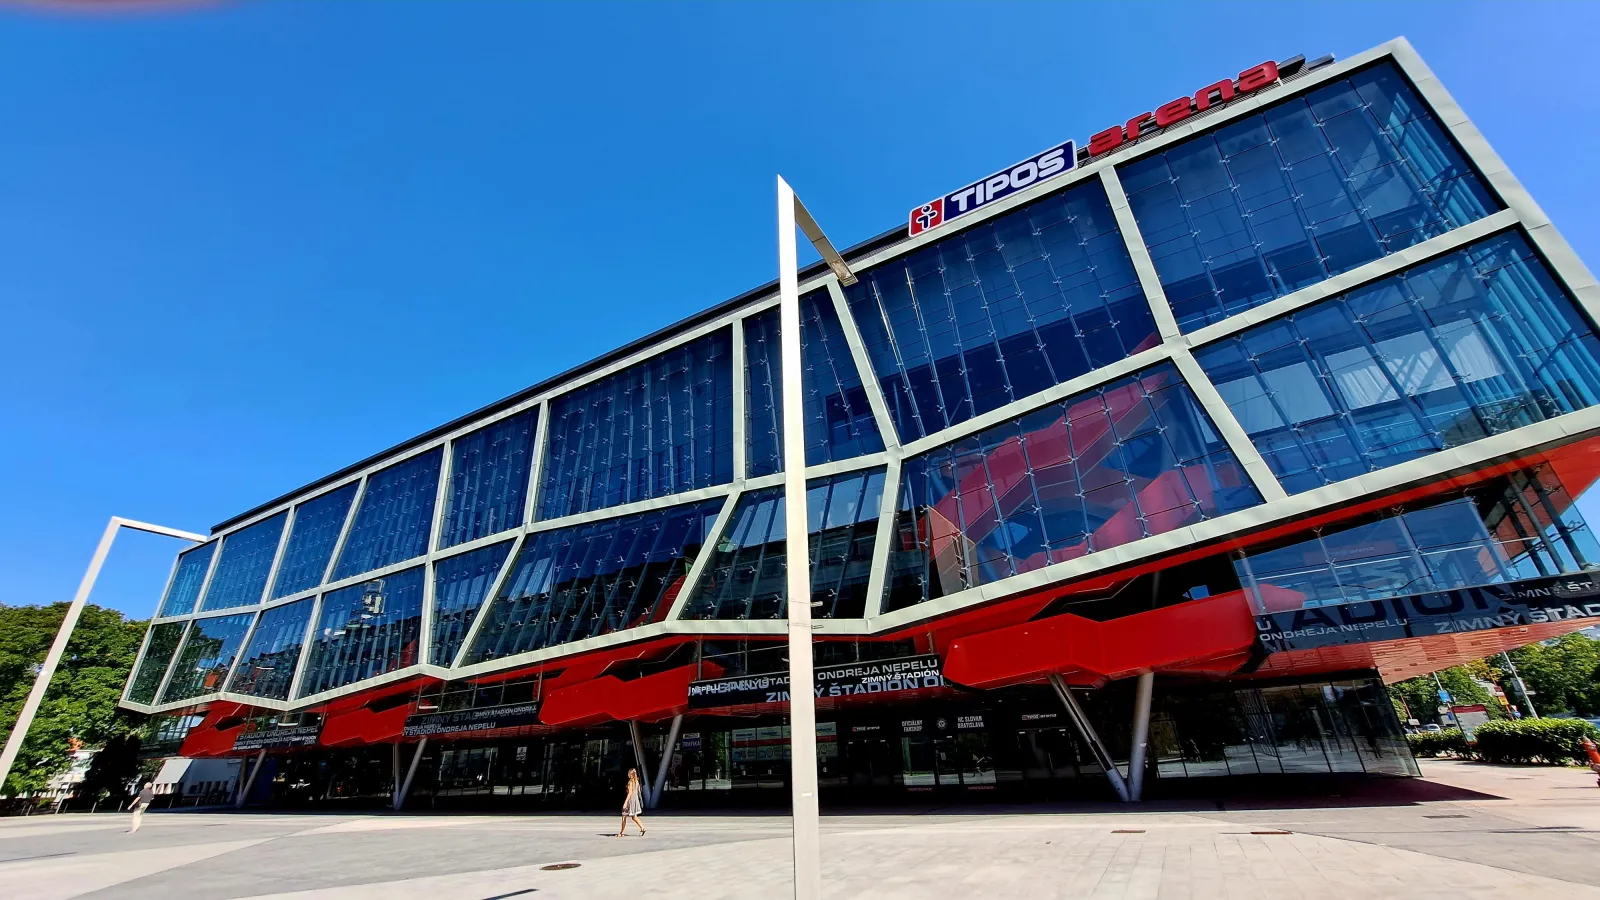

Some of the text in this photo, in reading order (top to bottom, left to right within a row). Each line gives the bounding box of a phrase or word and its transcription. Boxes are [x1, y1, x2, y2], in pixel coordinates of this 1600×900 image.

[951, 60, 1279, 212] TIPOS arena
[1260, 618, 1408, 642] ONDREJA NEPELU
[1434, 610, 1521, 634] ZIMNÝ
[817, 666, 880, 680] ONDREJA
[882, 659, 938, 674] NEPELU
[861, 669, 940, 684] ZIMNÝ ŠTADIÓN
[437, 724, 468, 735] ONDREJA
[467, 722, 497, 731] NEPELU
